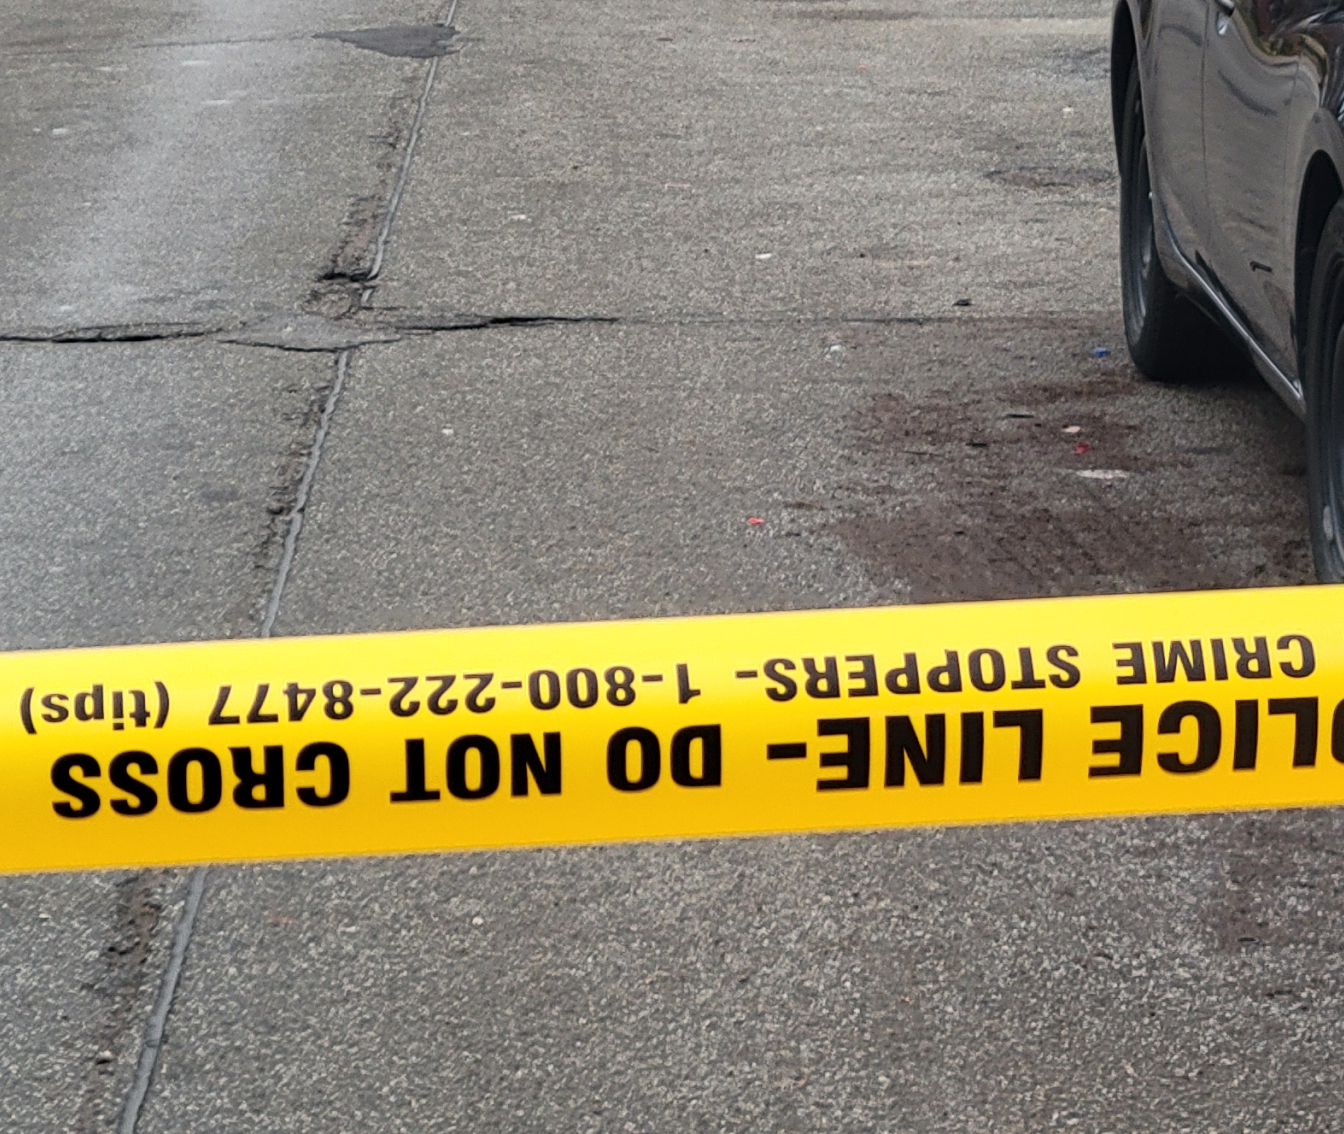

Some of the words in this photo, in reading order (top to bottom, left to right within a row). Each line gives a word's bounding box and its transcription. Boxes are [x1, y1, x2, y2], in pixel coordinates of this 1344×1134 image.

[1114, 634, 1316, 685] CRIME
[21, 682, 170, 735] (tips)
[209, 664, 702, 725] 1-800-222-8477
[50, 741, 351, 819] CROSS
[390, 731, 562, 803] NOT
[606, 723, 722, 792] DO
